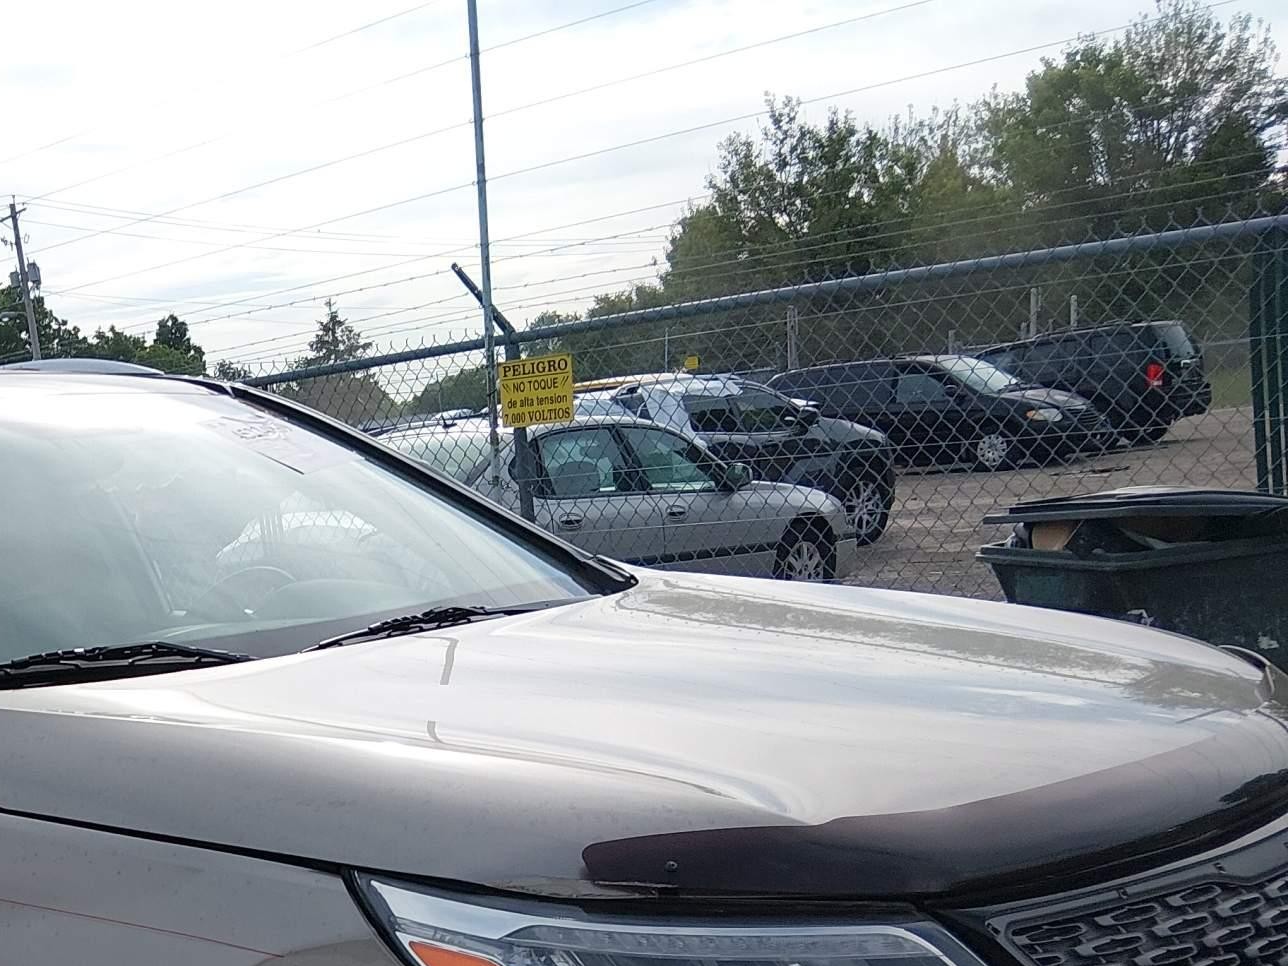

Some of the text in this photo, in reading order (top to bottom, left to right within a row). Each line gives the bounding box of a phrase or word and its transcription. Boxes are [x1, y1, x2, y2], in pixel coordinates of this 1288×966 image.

[502, 358, 568, 378] PELIGRO
[512, 377, 559, 393] NO TOQUE
[507, 393, 568, 409] de alta tension
[527, 407, 570, 422] VOLTIOS
